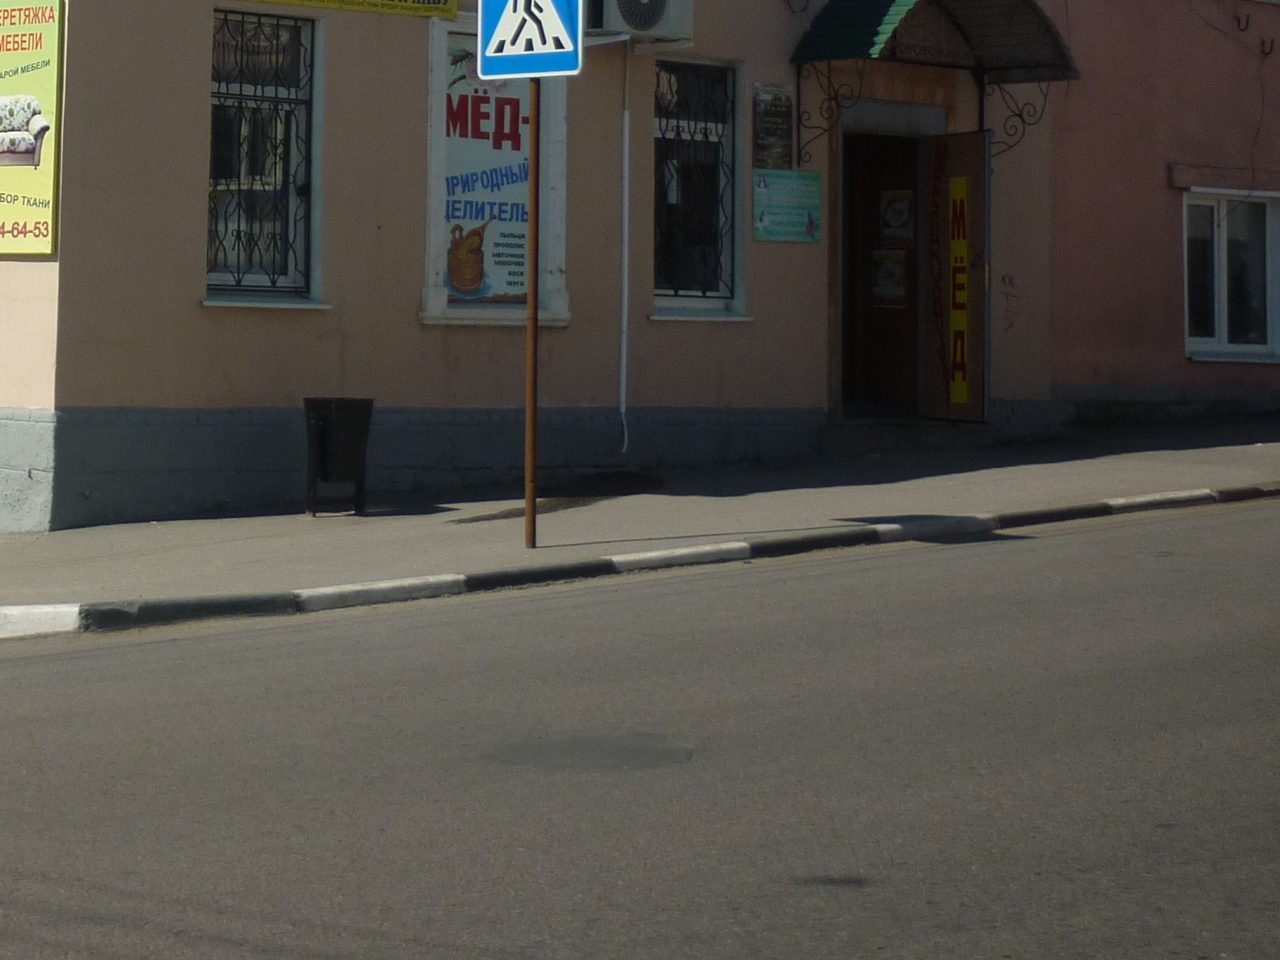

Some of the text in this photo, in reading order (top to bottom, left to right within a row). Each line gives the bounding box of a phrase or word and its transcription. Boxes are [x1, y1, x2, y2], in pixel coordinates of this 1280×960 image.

[20, 59, 51, 74] МЕБЕЛИ
[21, 195, 51, 209] ТКАНИ
[950, 198, 967, 382] МЁД
